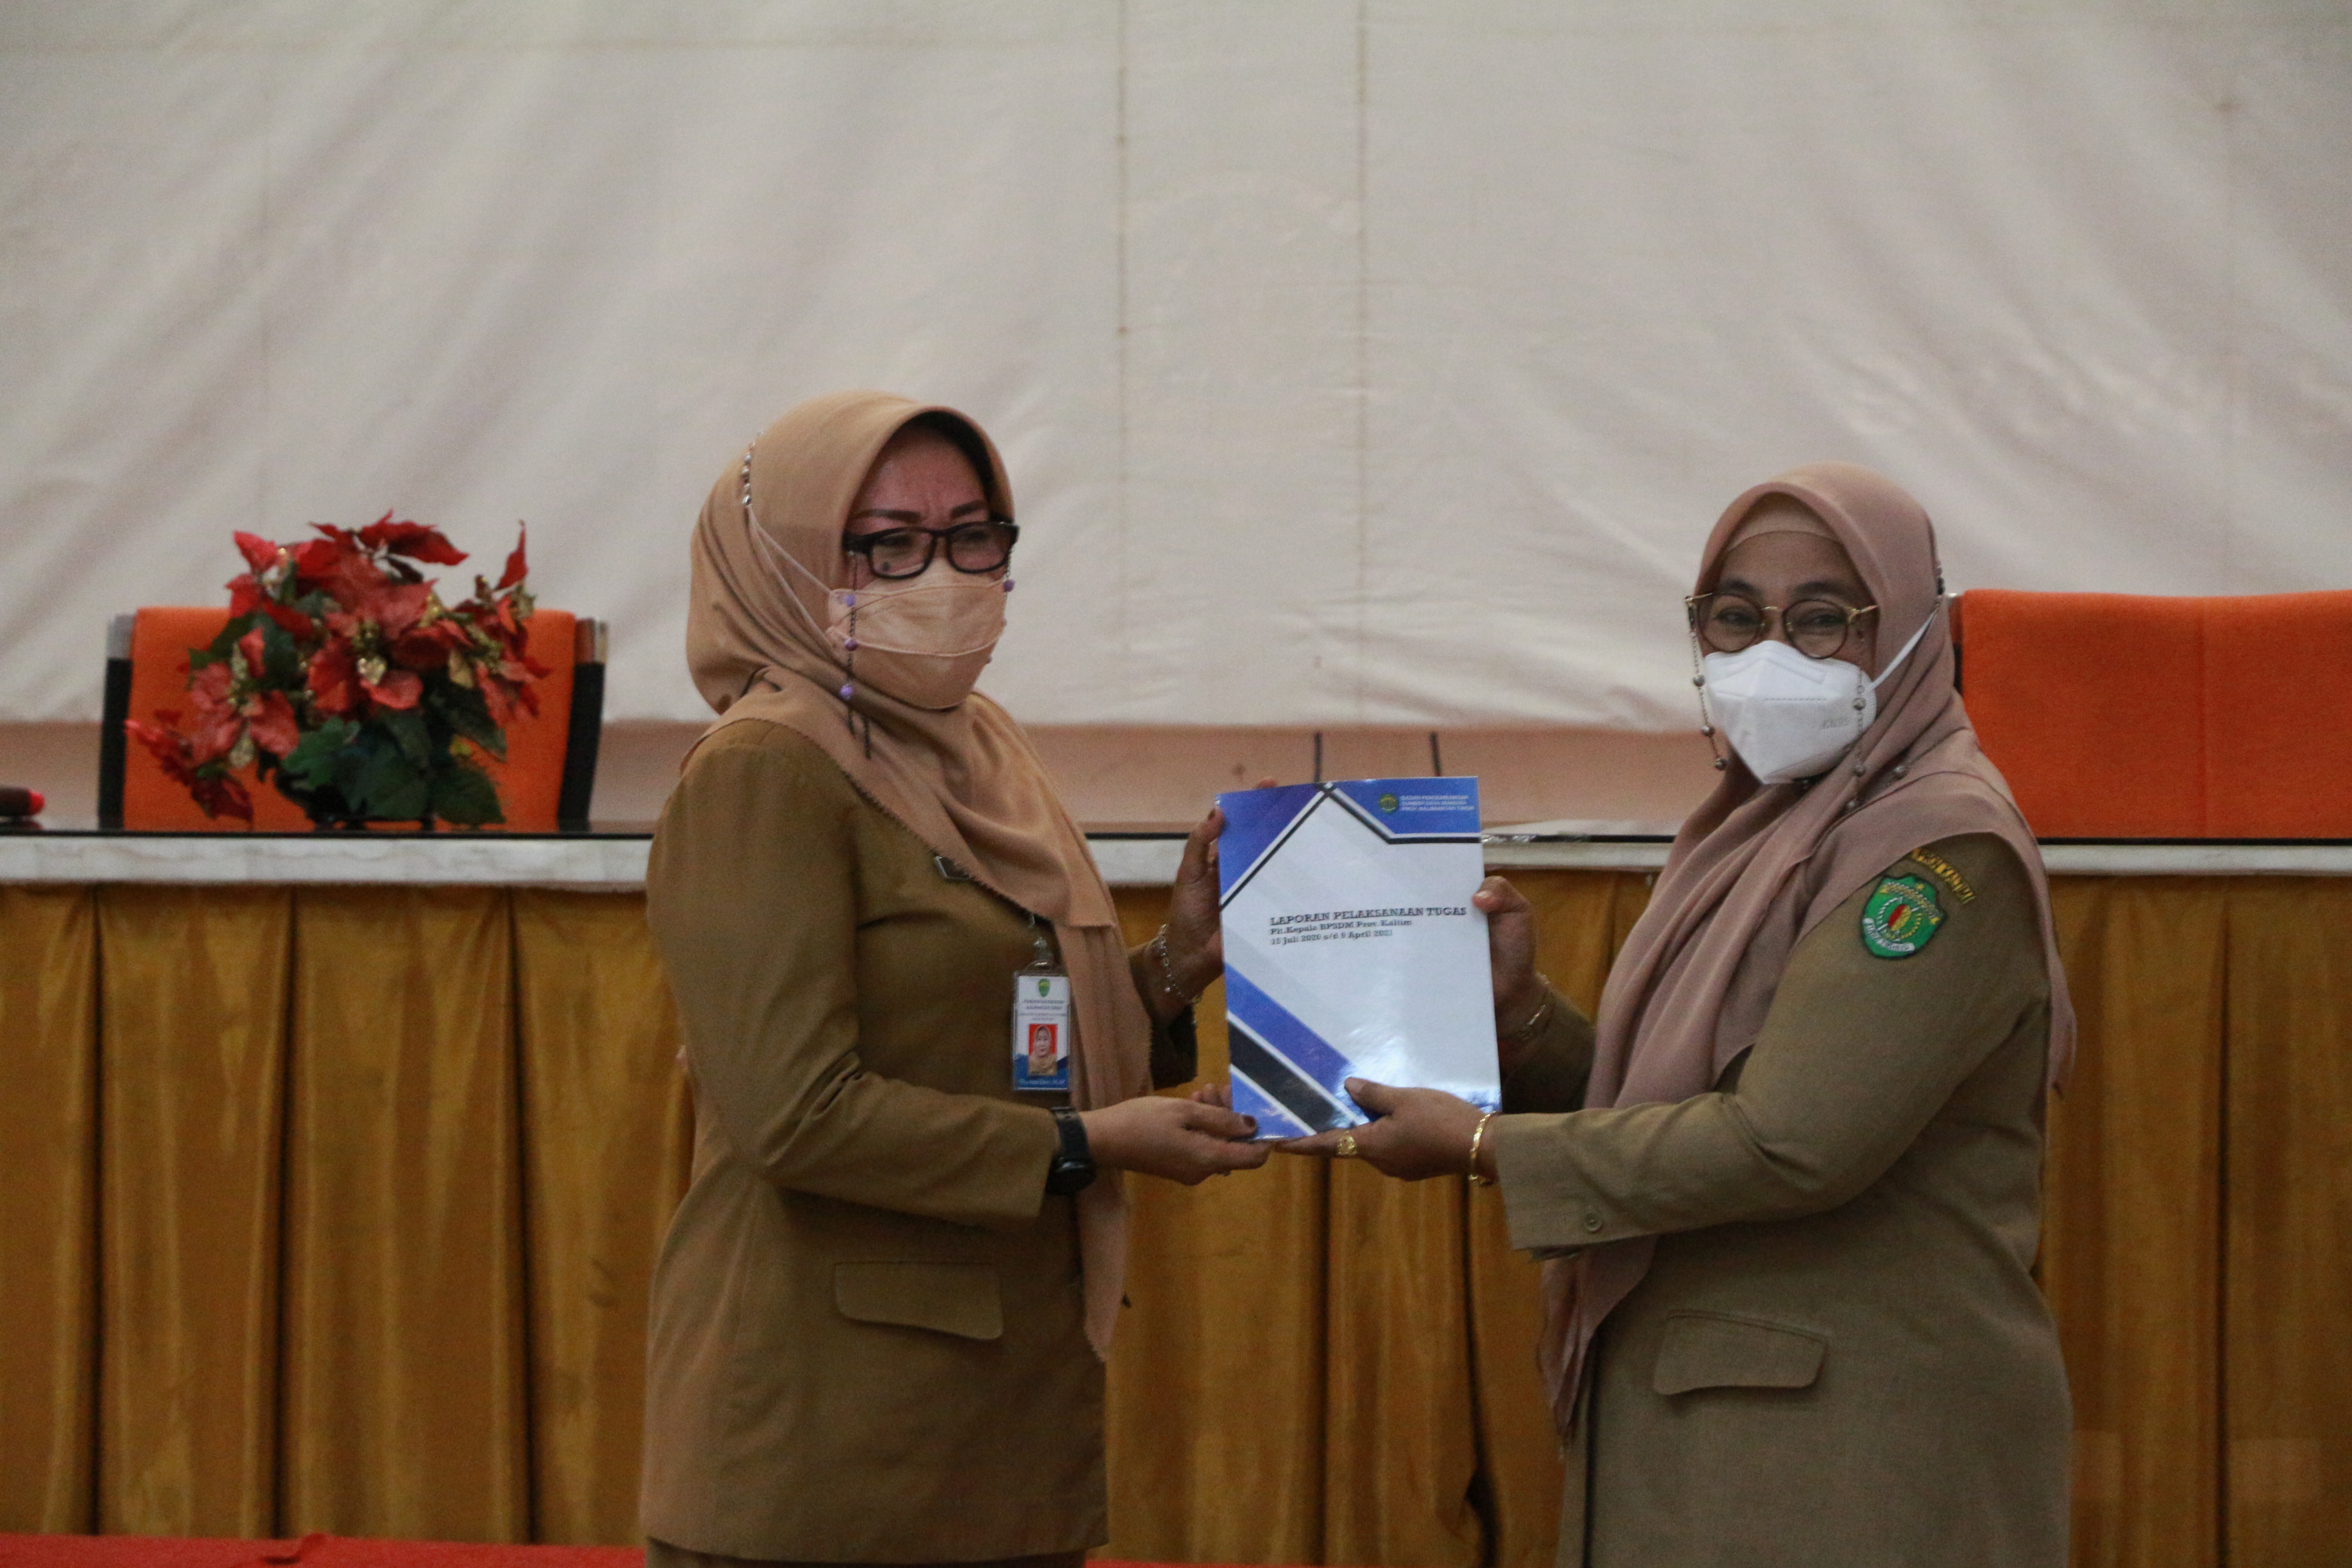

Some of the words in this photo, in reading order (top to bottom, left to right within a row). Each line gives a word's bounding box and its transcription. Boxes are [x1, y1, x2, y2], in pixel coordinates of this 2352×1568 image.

[1270, 912, 1330, 926] LAPORAN
[1333, 908, 1423, 920] PELAKSANAAN
[1426, 907, 1466, 916] TUGAS
[1320, 921, 1354, 930] BPSDM
[1283, 936, 1299, 945] Juli
[1348, 931, 1371, 939] April
